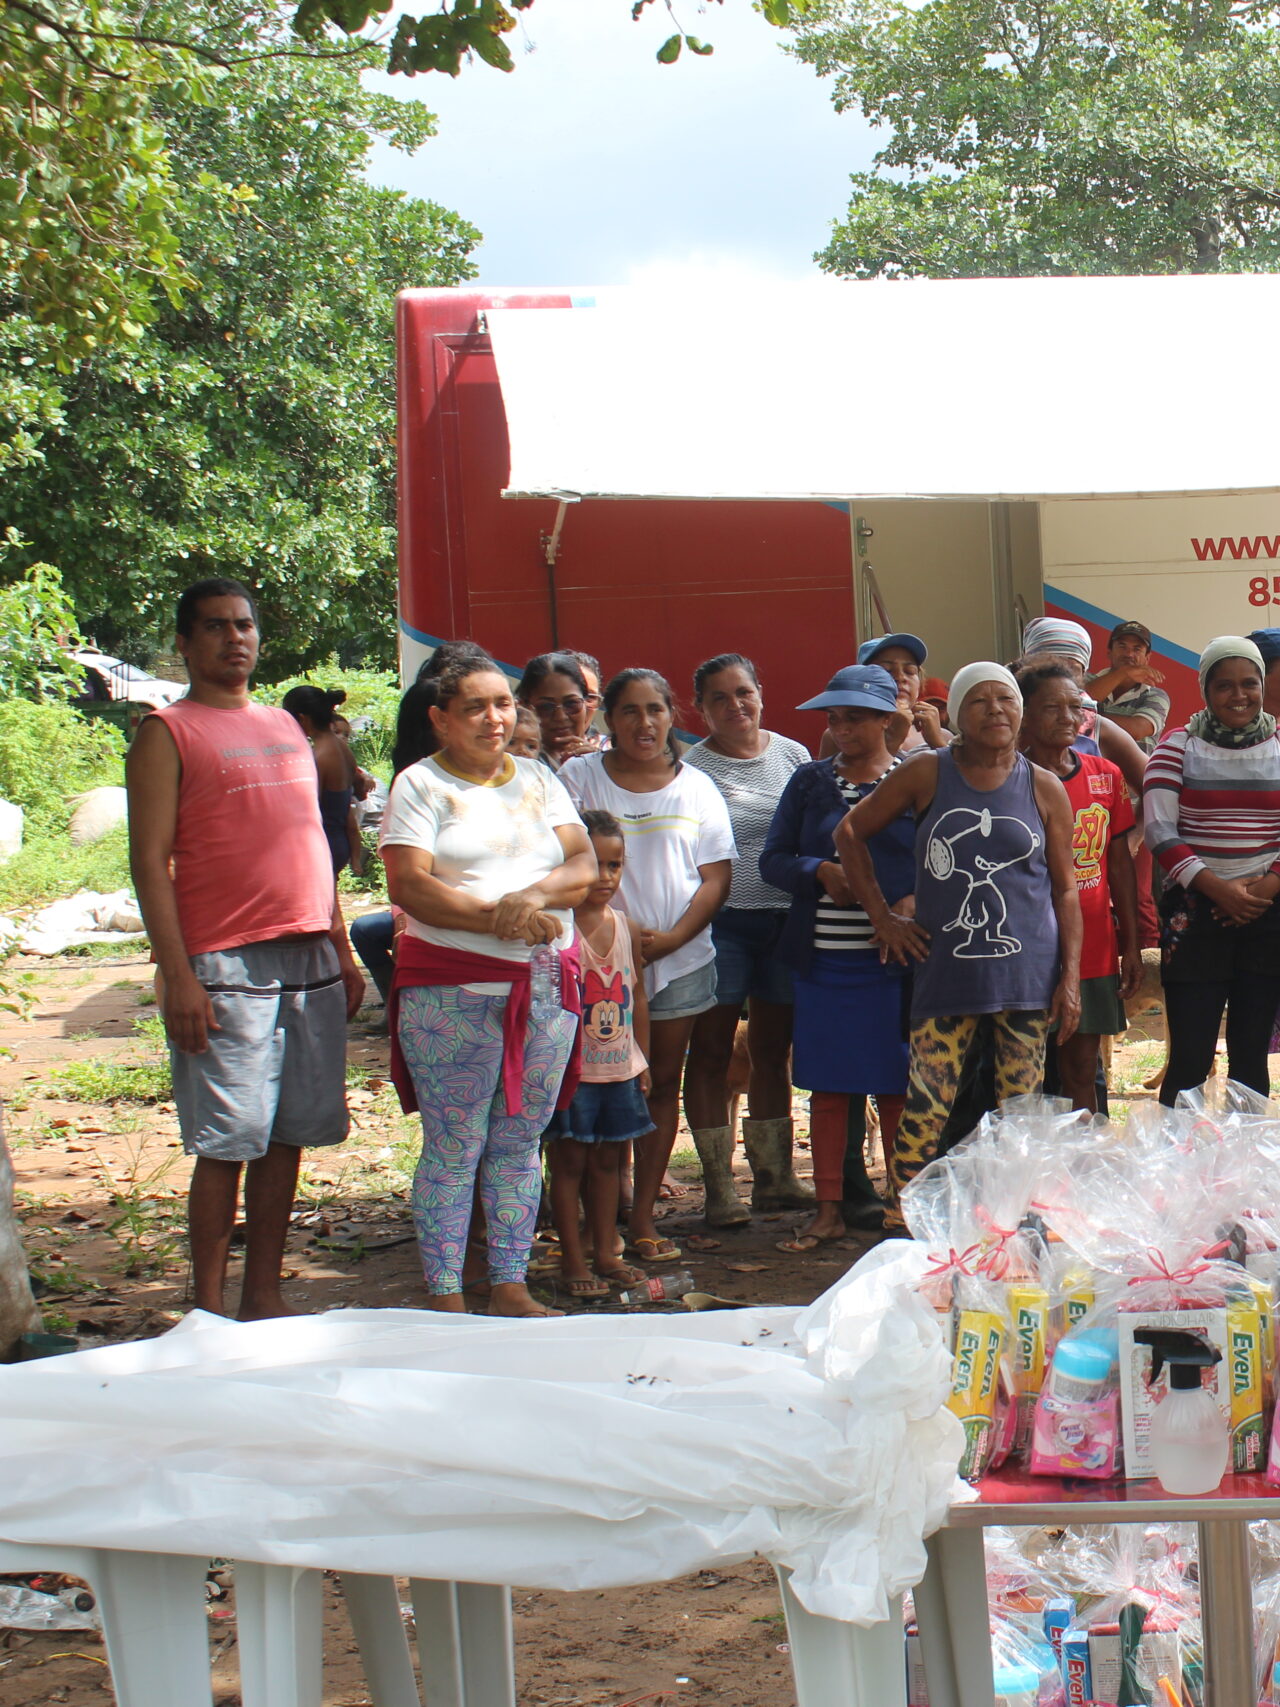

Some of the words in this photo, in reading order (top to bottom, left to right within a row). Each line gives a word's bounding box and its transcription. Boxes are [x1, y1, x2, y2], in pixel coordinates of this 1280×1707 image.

[953, 1329, 981, 1396] Even
[980, 1328, 1001, 1399] Even
[1017, 1308, 1042, 1371] Even
[1231, 1331, 1254, 1396] Even
[1067, 1658, 1086, 1706] Even
